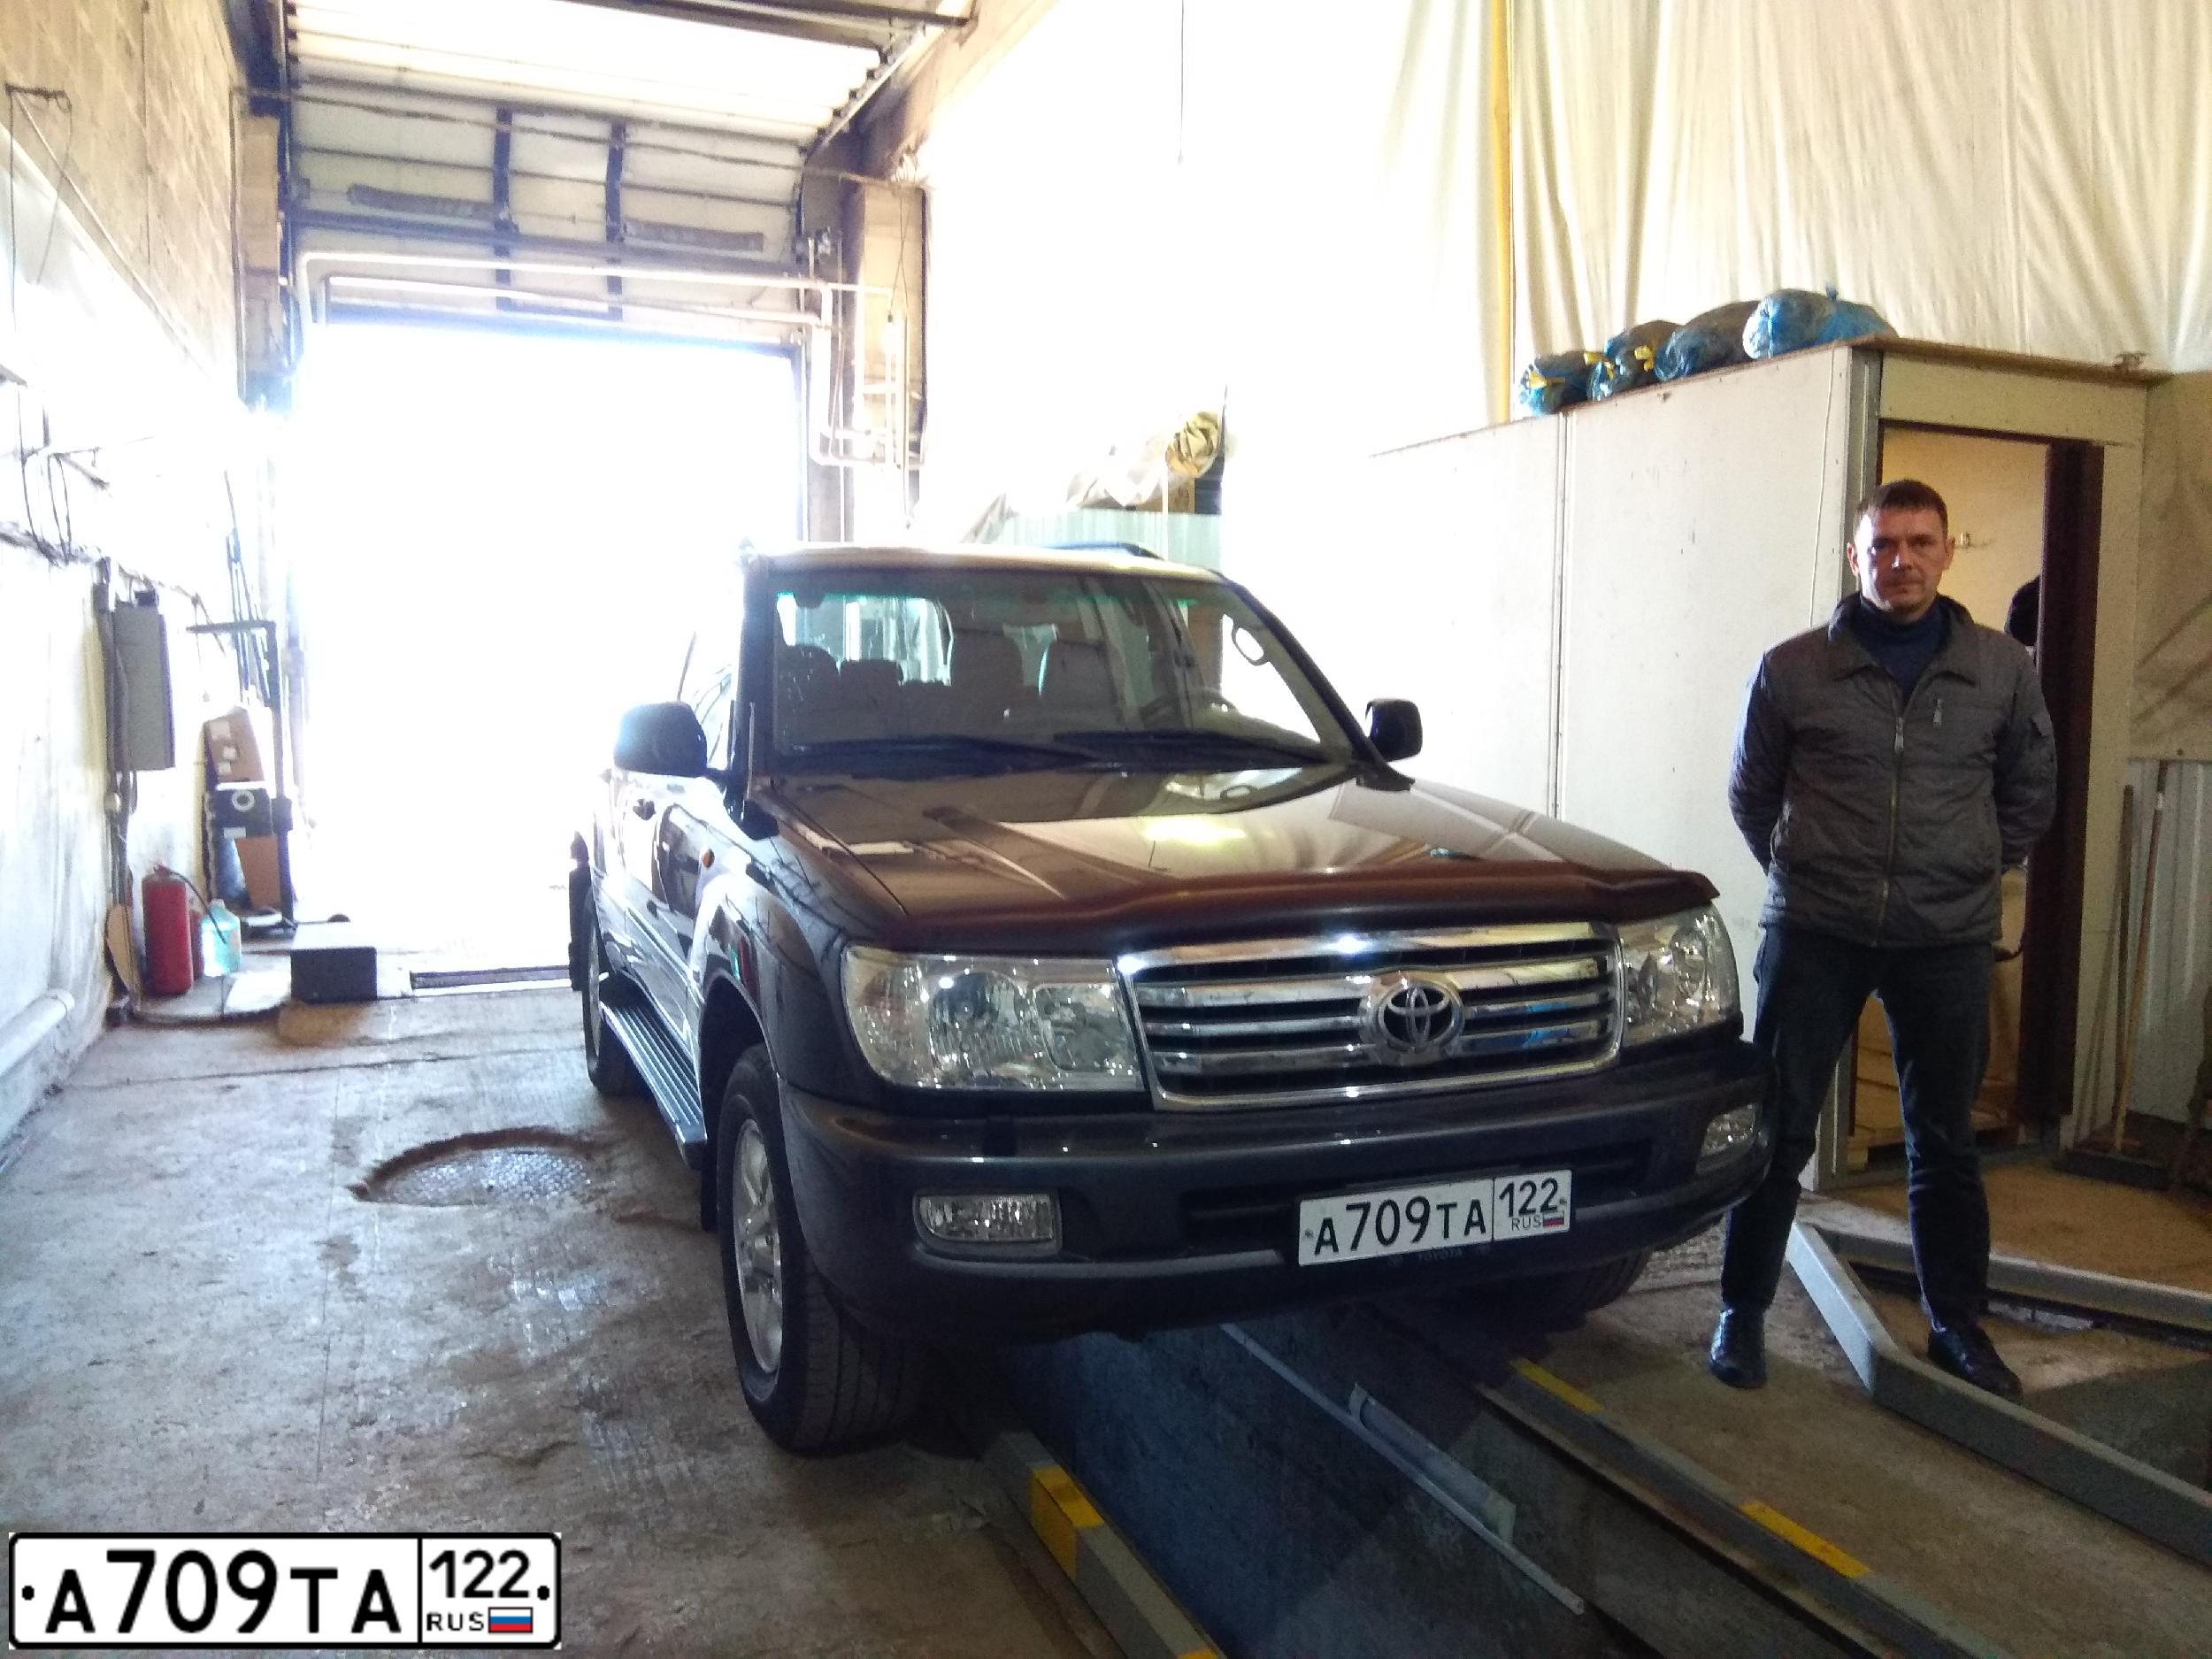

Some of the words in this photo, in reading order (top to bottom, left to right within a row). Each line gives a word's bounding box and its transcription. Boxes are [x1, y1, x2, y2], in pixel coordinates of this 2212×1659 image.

[1499, 1177, 1559, 1217] 122
[1314, 1195, 1486, 1255] A709TA
[1511, 1215, 1542, 1232] RUS
